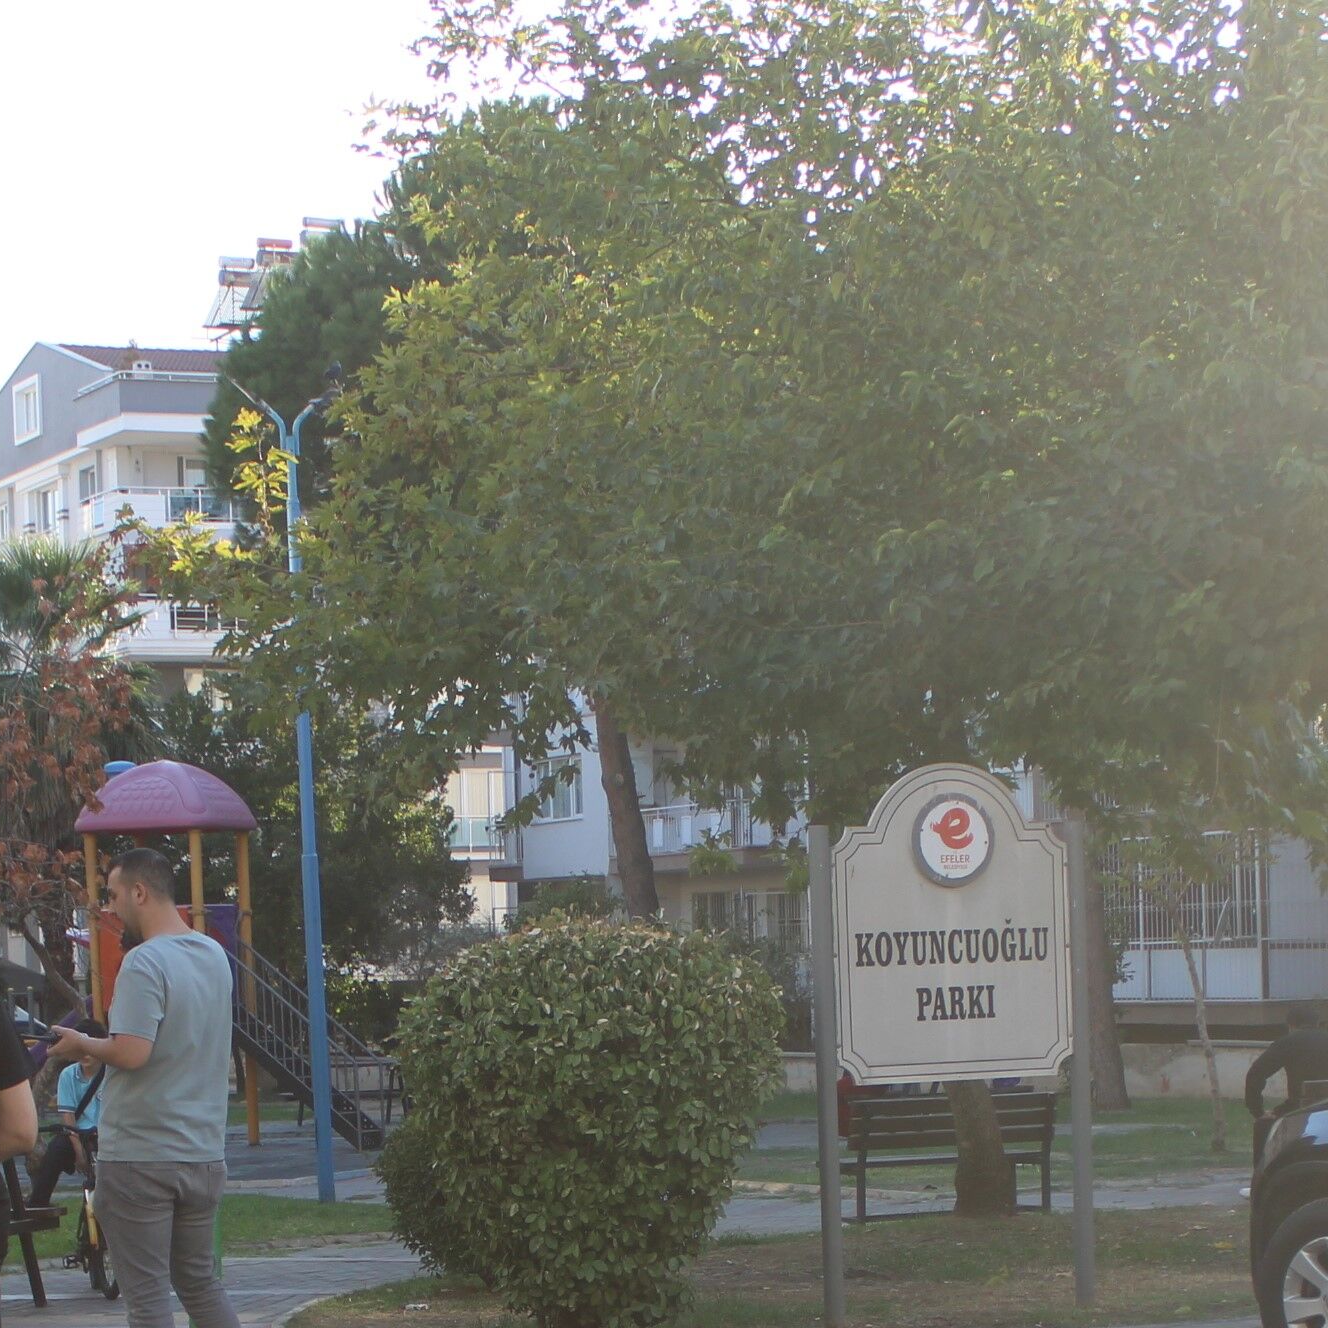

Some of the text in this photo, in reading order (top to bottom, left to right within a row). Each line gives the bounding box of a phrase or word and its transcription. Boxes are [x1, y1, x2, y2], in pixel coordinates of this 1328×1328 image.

[940, 854, 970, 864] EFELER
[854, 918, 1049, 968] KOYUNCUOĞLU
[916, 985, 996, 1022] PARKI
